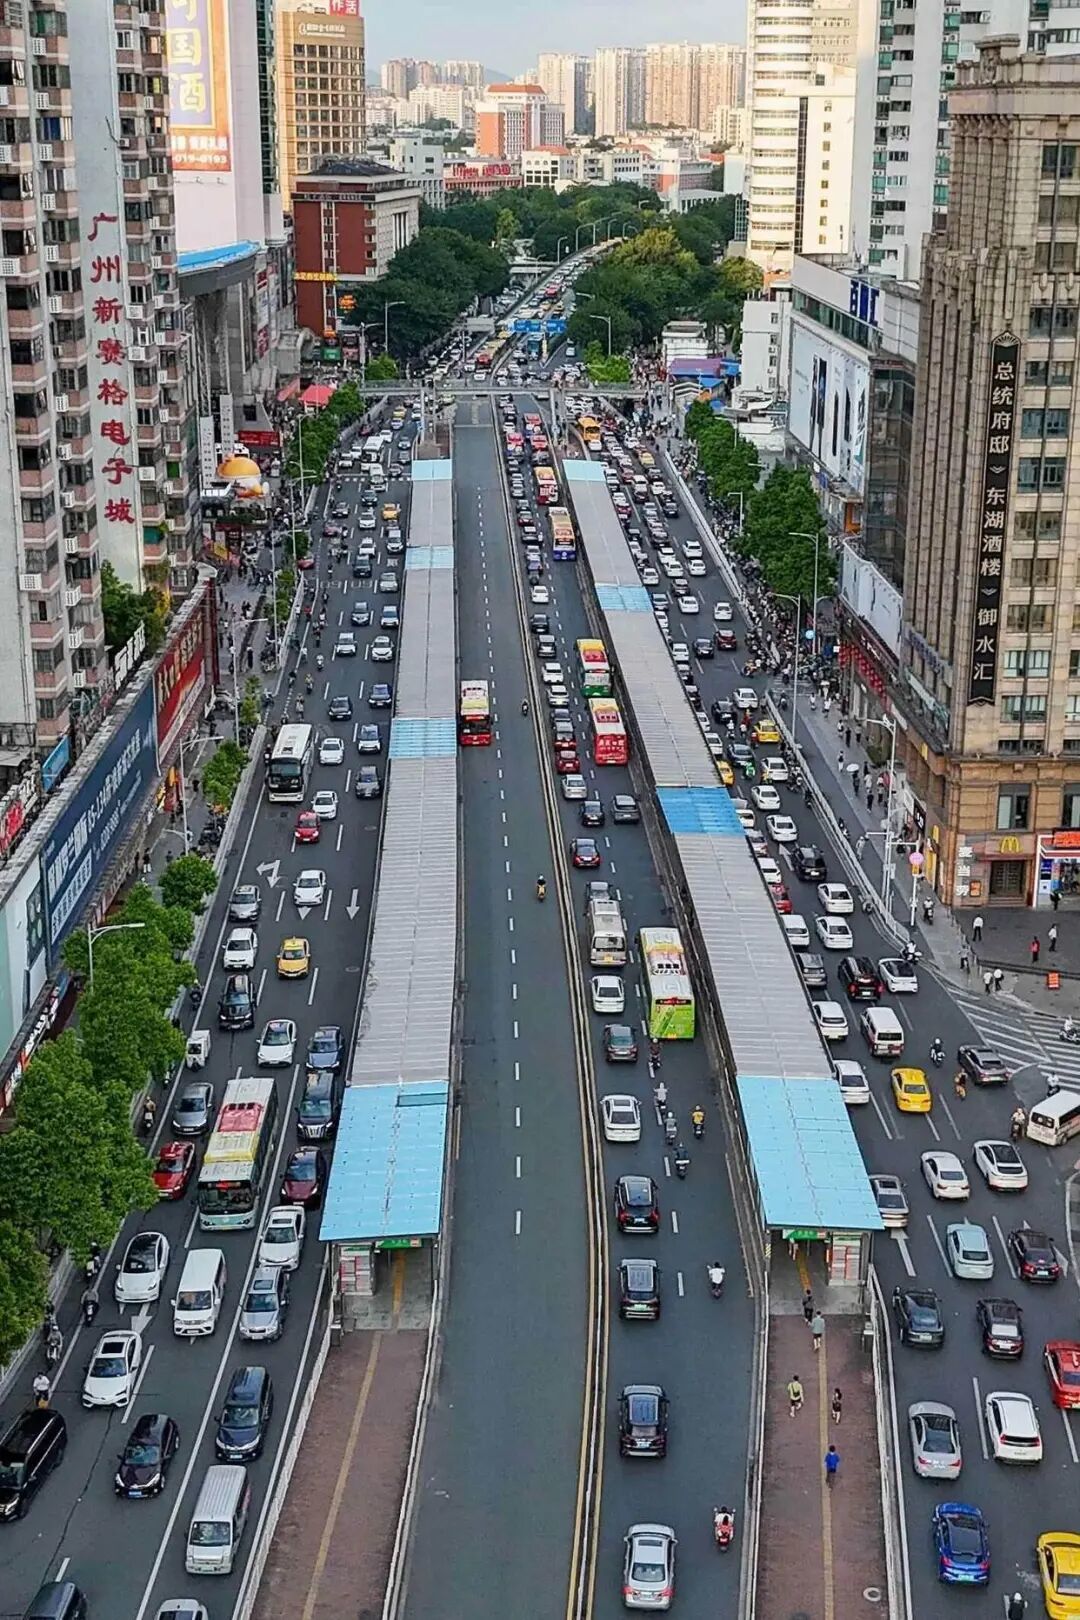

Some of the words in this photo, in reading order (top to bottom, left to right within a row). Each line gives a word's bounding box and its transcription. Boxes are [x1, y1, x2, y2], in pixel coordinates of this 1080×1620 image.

[88, 212, 134, 523] 广州新赛格电子城
[989, 361, 1014, 455] 总统府邸
[981, 487, 1005, 578] 东湖酒楼
[973, 608, 997, 681] 御水汇
